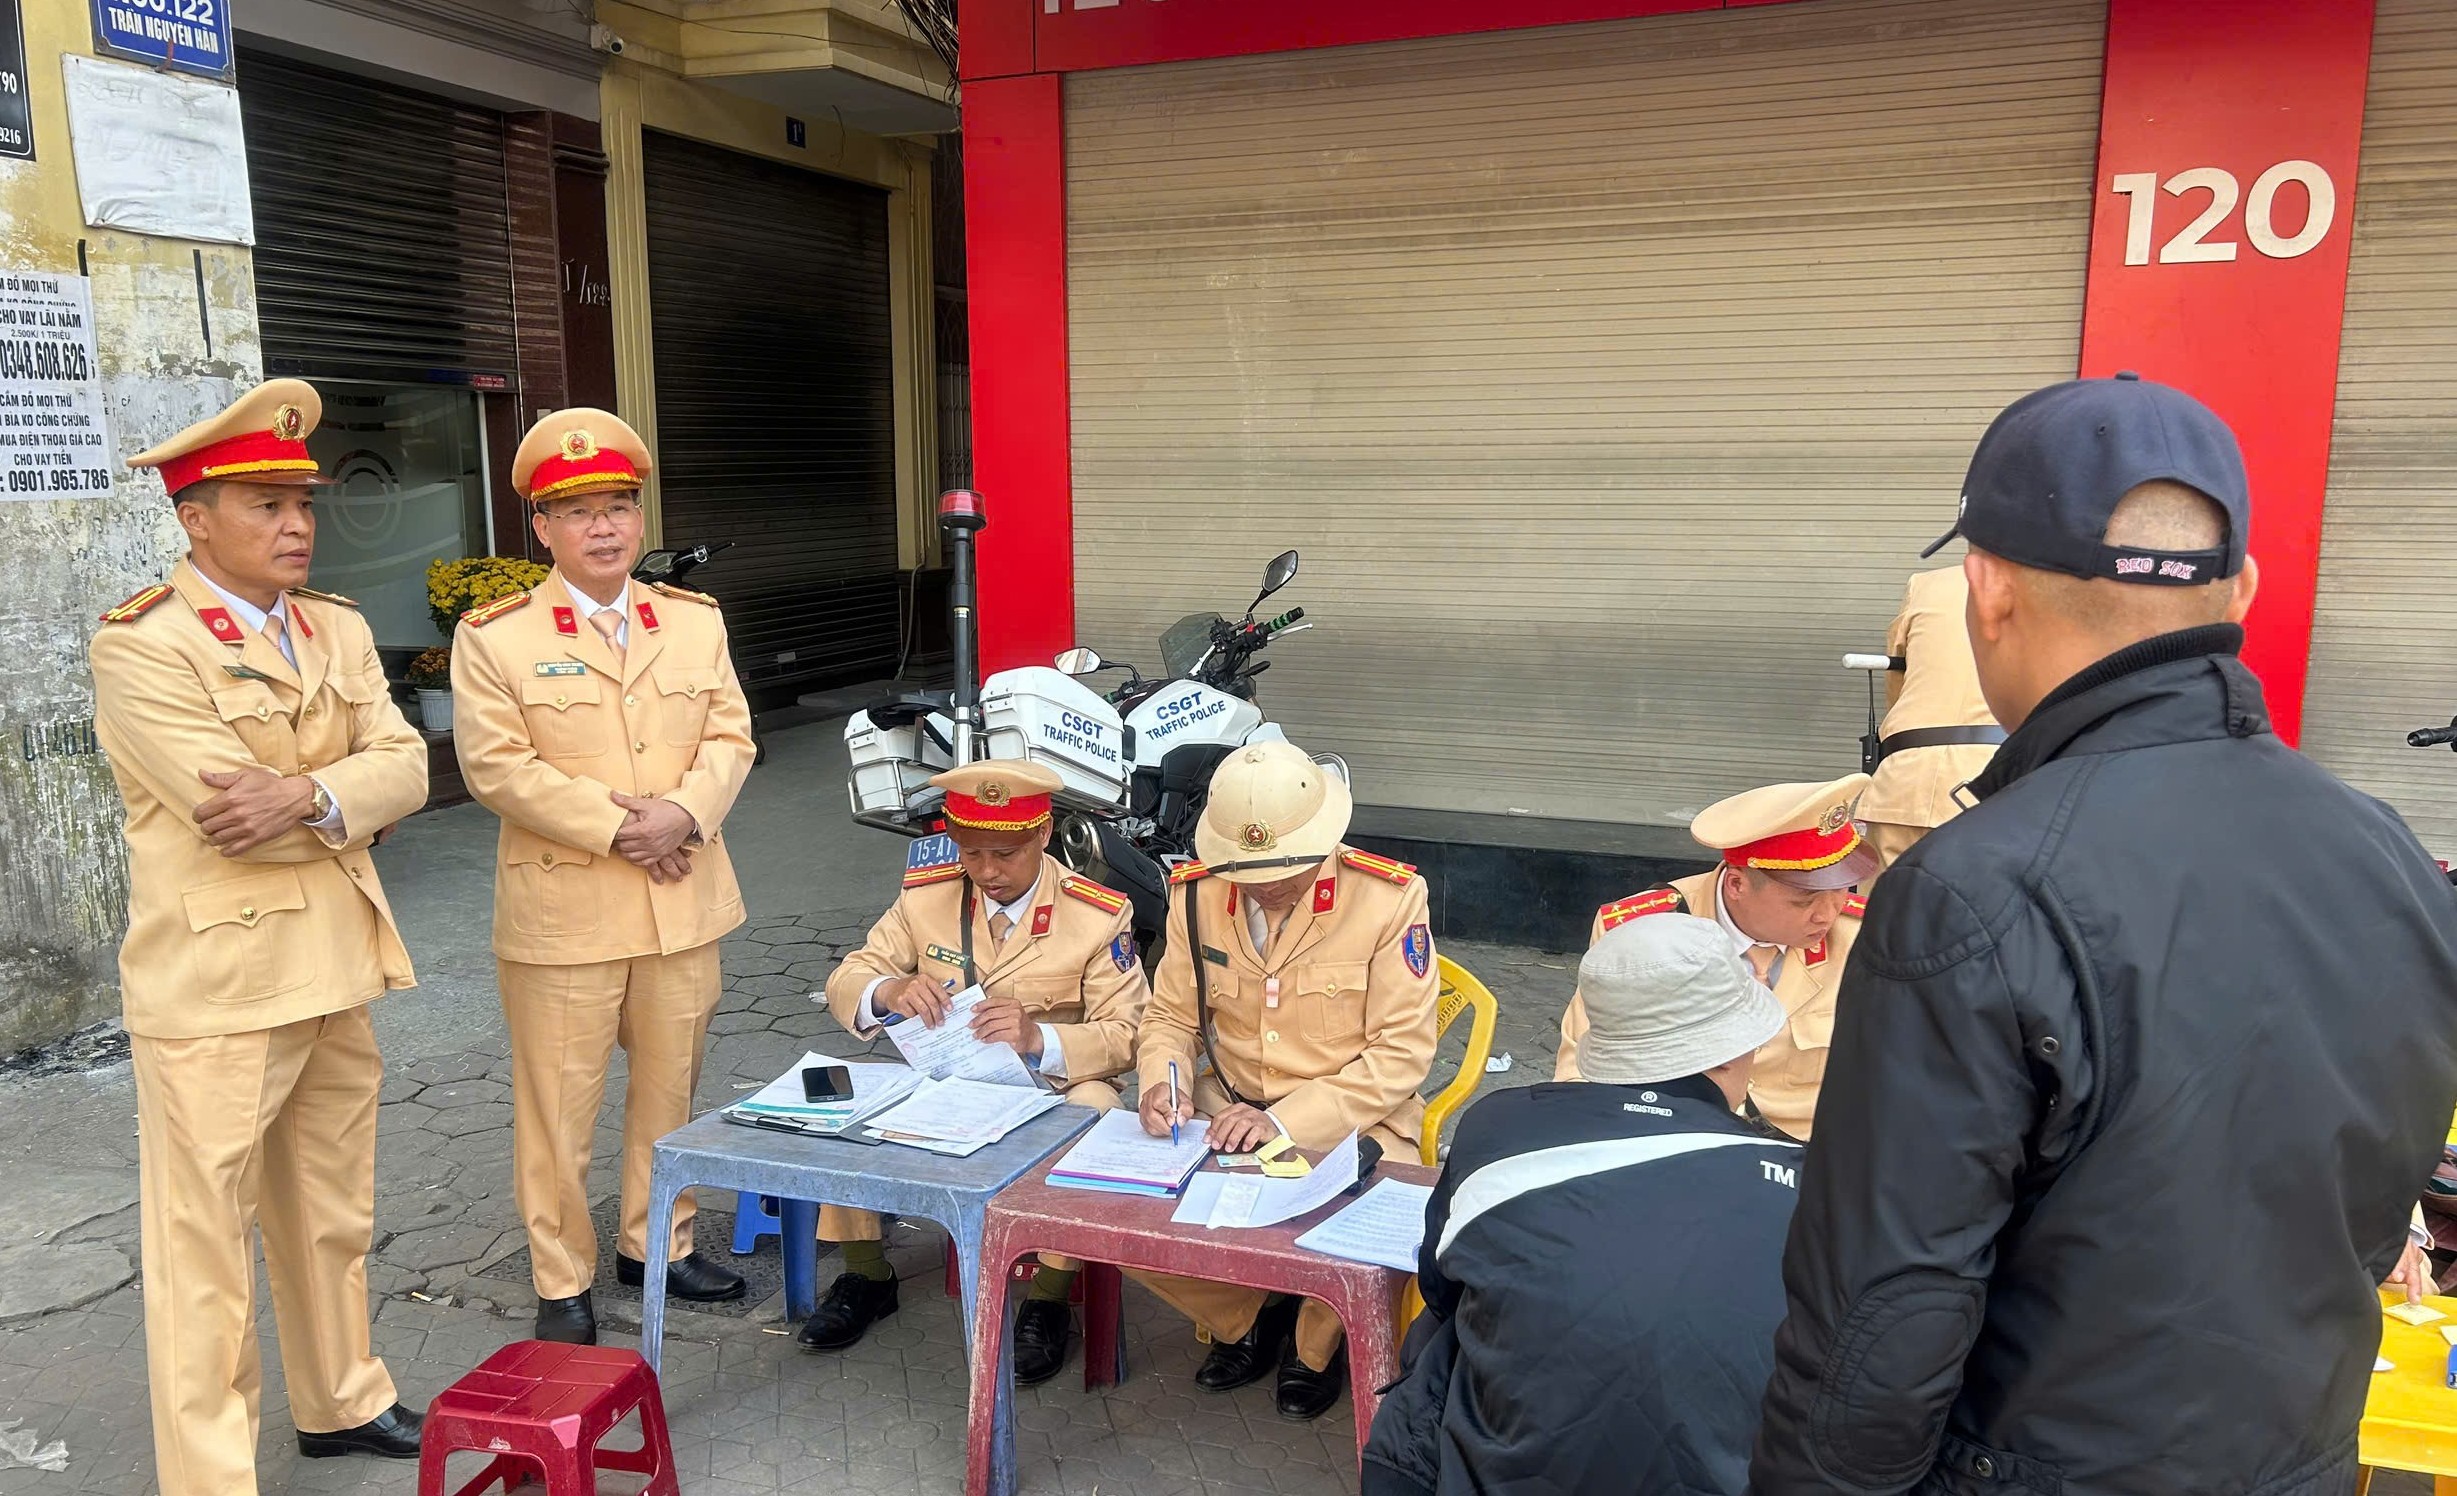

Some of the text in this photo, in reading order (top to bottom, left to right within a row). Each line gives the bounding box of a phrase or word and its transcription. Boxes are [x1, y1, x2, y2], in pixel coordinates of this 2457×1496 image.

[108, 7, 143, 36] TRẦN
[112, 0, 214, 26] .122
[0, 72, 17, 94] 90
[2112, 160, 2336, 266] 120
[22, 279, 39, 294] MỌI
[19, 310, 36, 325] VAY
[40, 309, 56, 327] LÃI
[0, 339, 87, 381] 0348.608.626
[36, 393, 53, 410] MỌI
[21, 414, 33, 427] KO
[35, 411, 59, 427] CÔNG
[61, 411, 90, 427] CHỨNG
[19, 431, 40, 449] ĐIỆN
[41, 434, 67, 448] THOẠI
[85, 434, 102, 446] CAO
[14, 453, 33, 466] CHO
[34, 453, 51, 466] VAY
[8, 468, 110, 492] 0901.965.786
[2115, 558, 2197, 580] RED SOX
[1157, 691, 1202, 720] CSGT
[1062, 711, 1104, 739] CSGT
[1145, 700, 1226, 741] TRAFFIC POLICE
[1043, 723, 1117, 762] TRAFFIC POLICE
[917, 836, 952, 862] 15-A1
[1623, 1102, 1673, 1117] REGISTERED
[1759, 1160, 1796, 1188] TM
